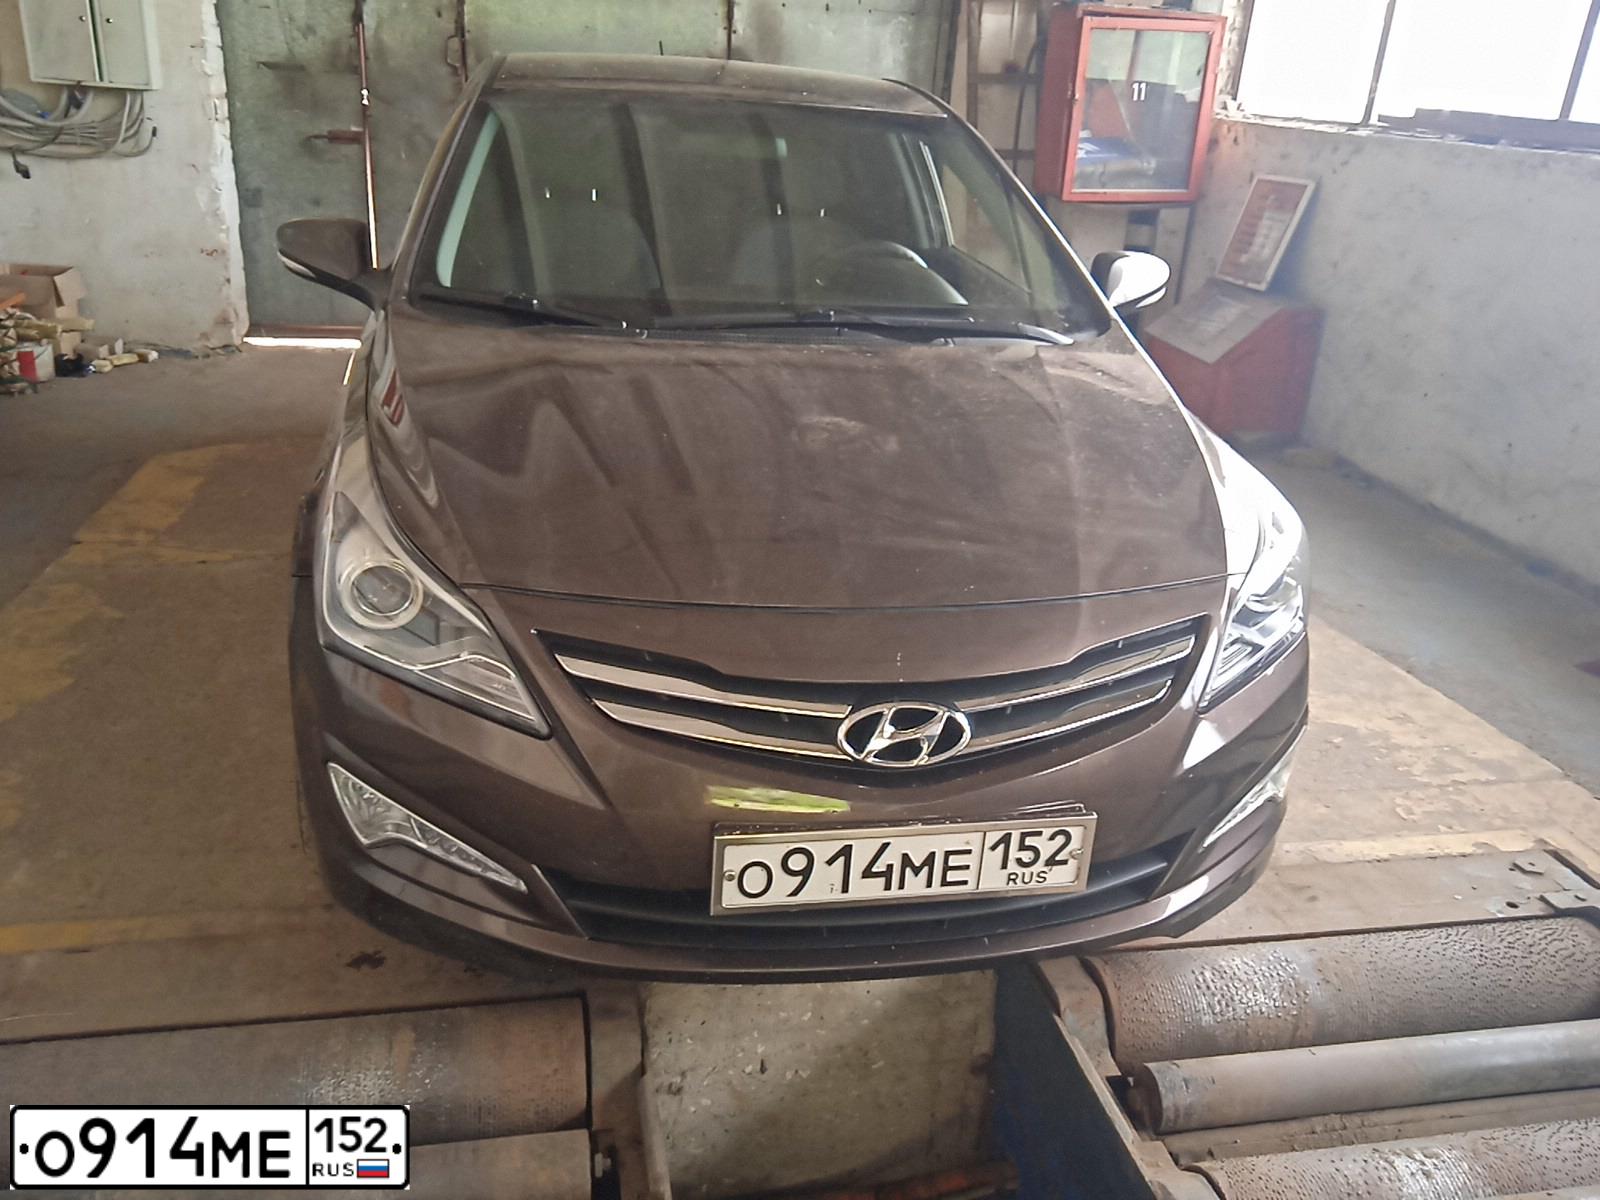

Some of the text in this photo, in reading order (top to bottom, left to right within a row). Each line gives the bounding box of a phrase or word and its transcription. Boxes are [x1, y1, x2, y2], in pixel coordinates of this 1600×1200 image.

[1132, 82, 1147, 101] 11
[989, 828, 1073, 870] 152
[1006, 870, 1048, 886] RUS
